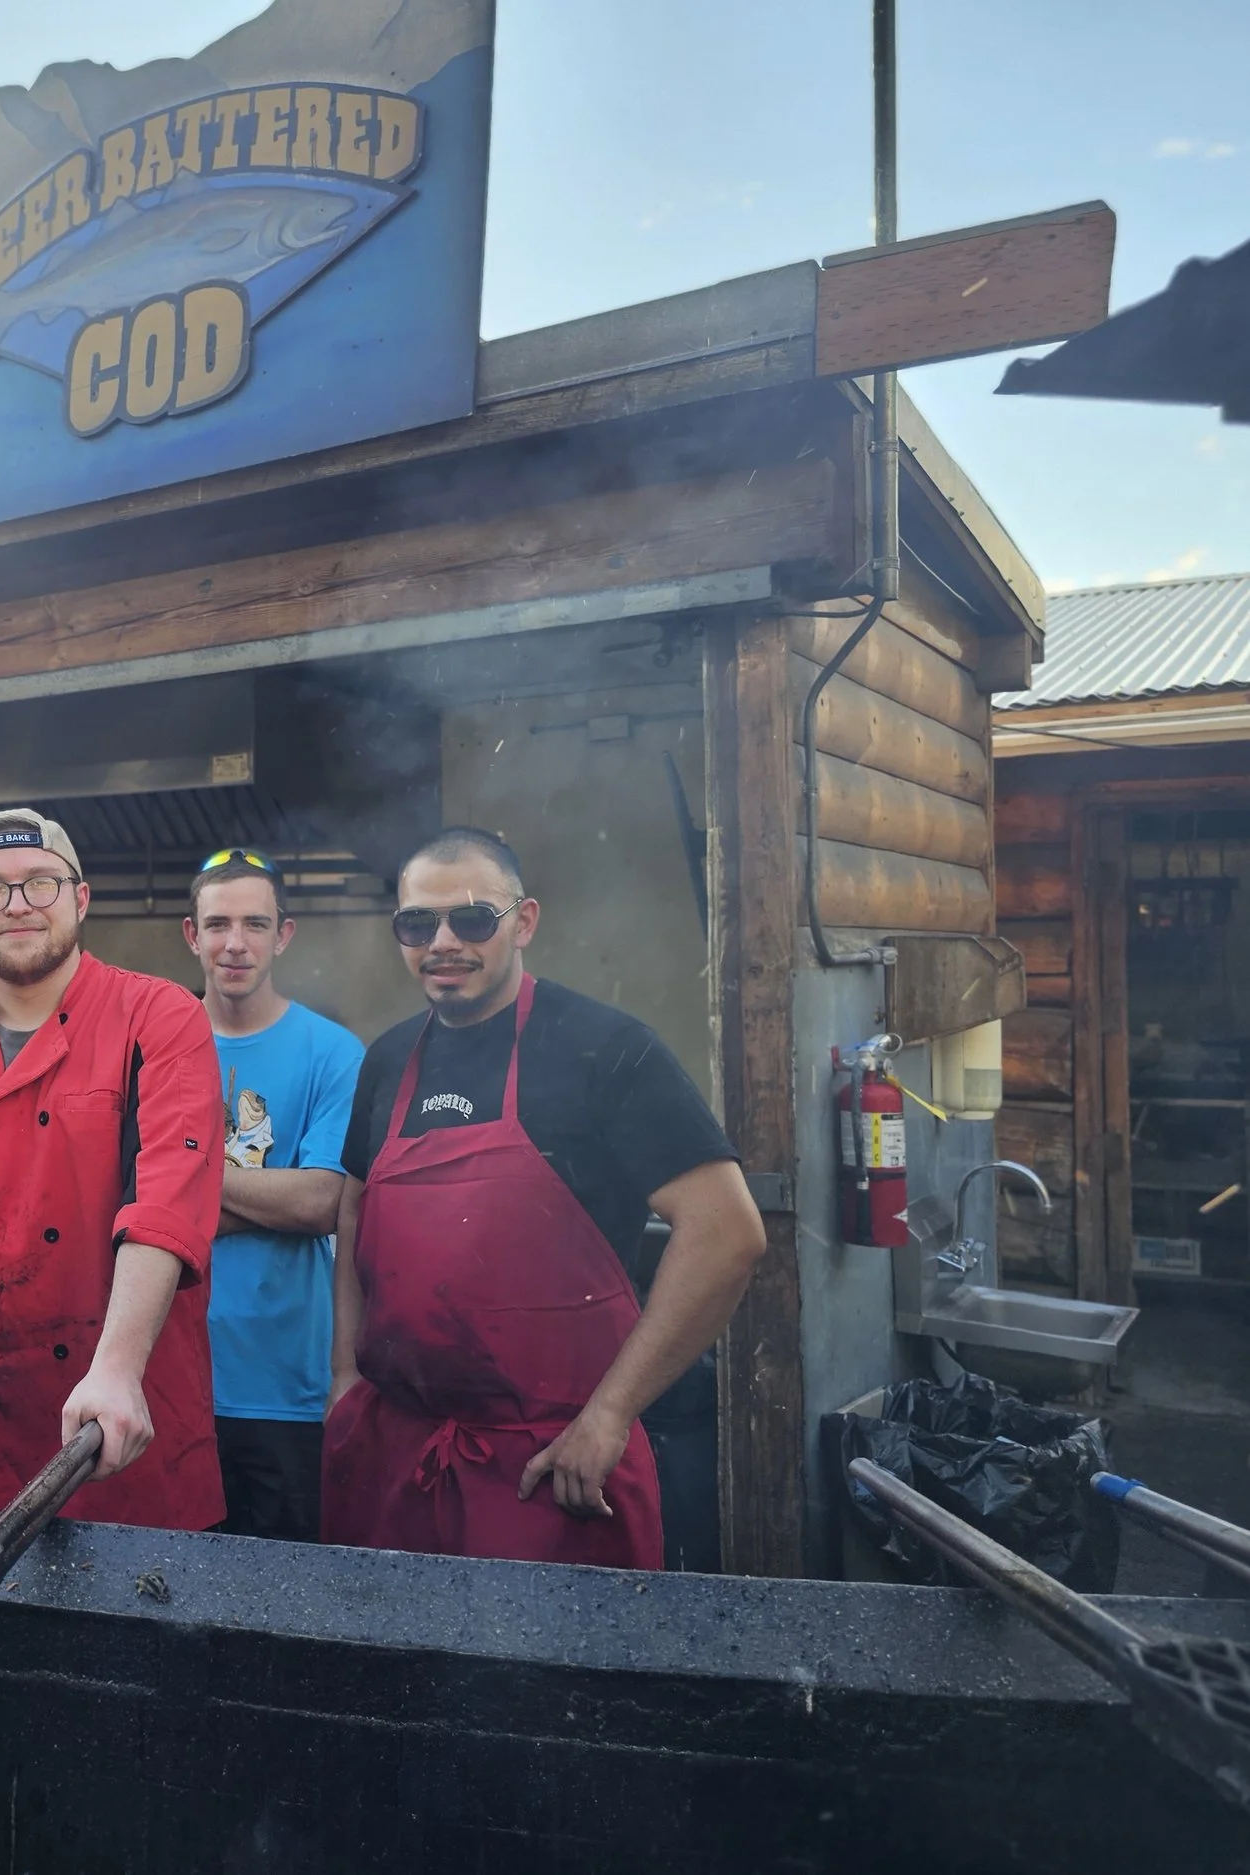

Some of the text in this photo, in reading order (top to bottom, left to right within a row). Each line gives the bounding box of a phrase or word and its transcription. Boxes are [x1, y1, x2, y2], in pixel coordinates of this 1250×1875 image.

[98, 86, 420, 212] BATTERED
[69, 286, 245, 434] COD
[5, 834, 31, 842] BAKE
